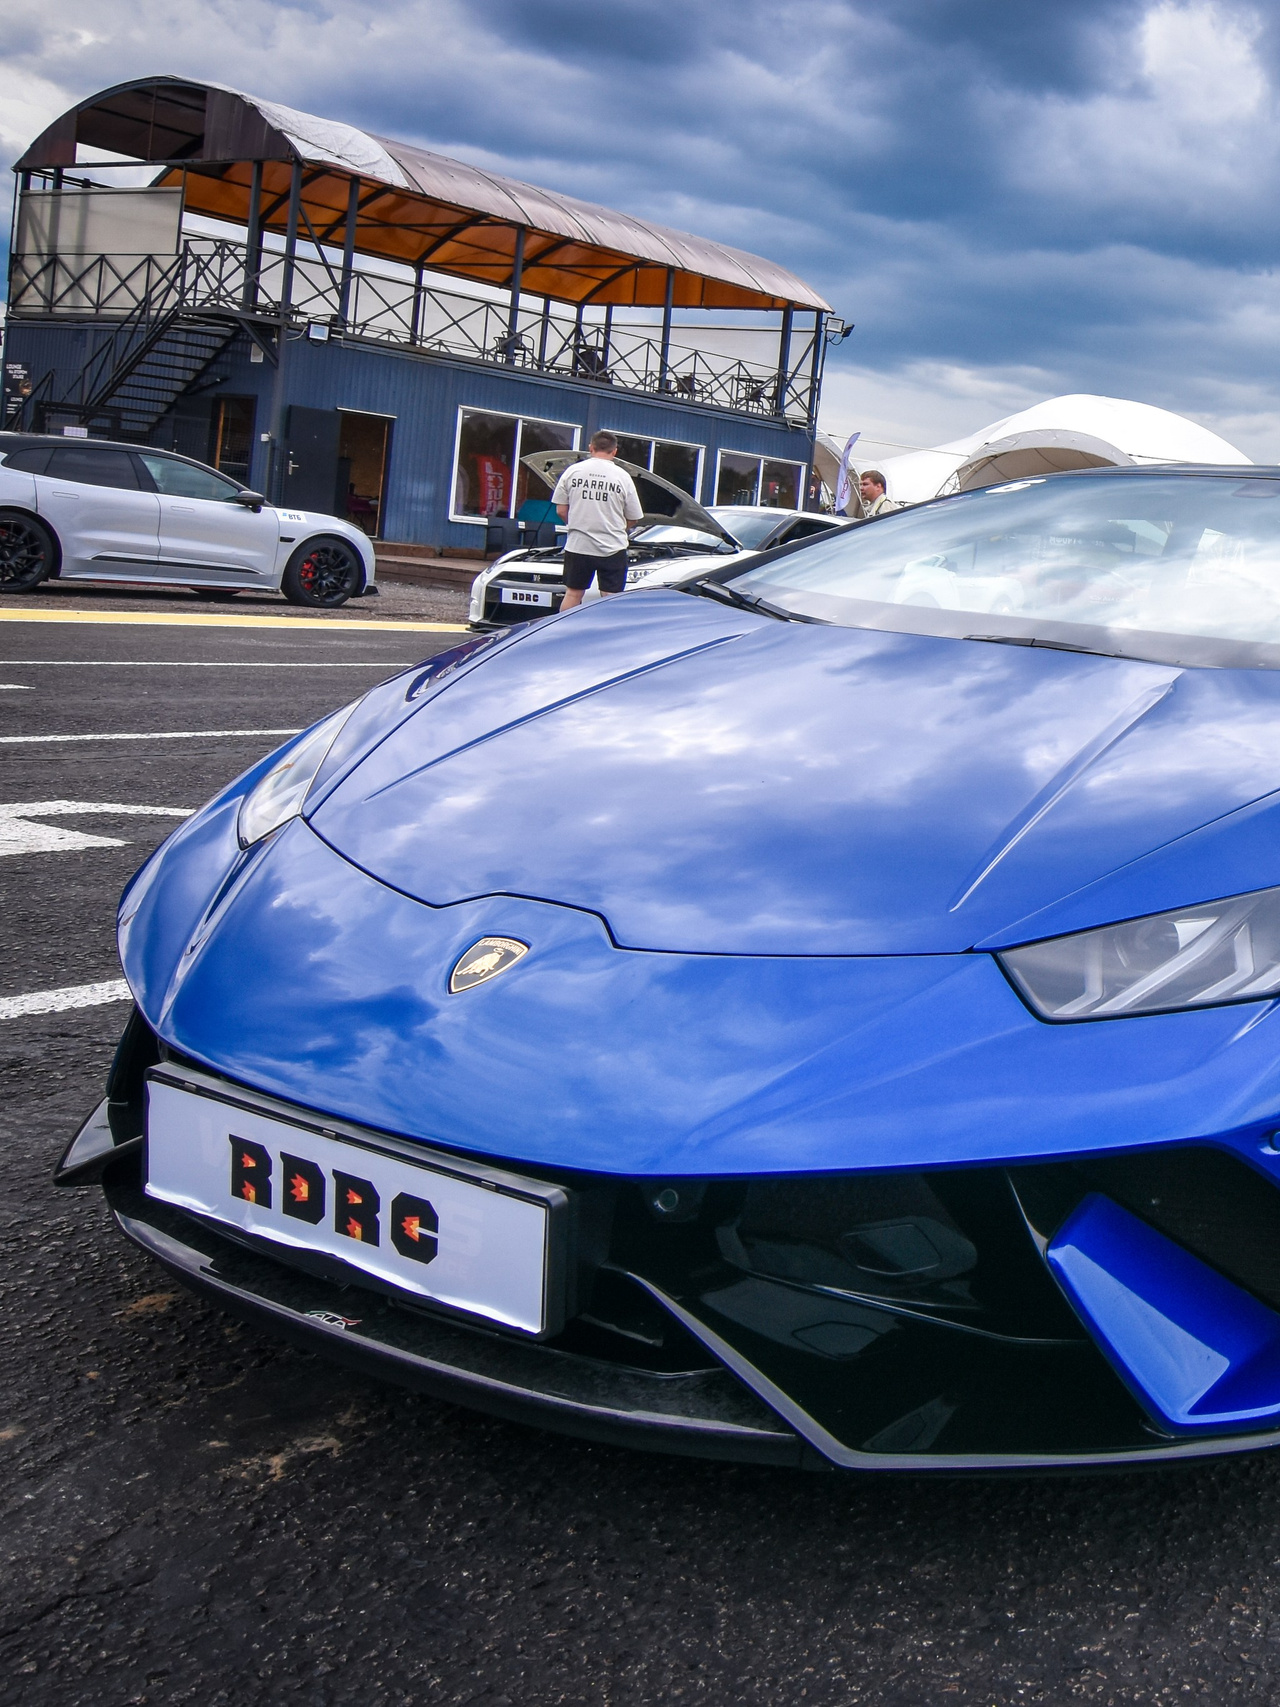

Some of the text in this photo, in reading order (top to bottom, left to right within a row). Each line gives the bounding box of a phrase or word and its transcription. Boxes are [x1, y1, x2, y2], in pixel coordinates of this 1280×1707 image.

[571, 478, 622, 494] SPARRING
[581, 490, 609, 502] CLUB
[512, 592, 539, 602] RDRC
[228, 1133, 439, 1265] RDRC
